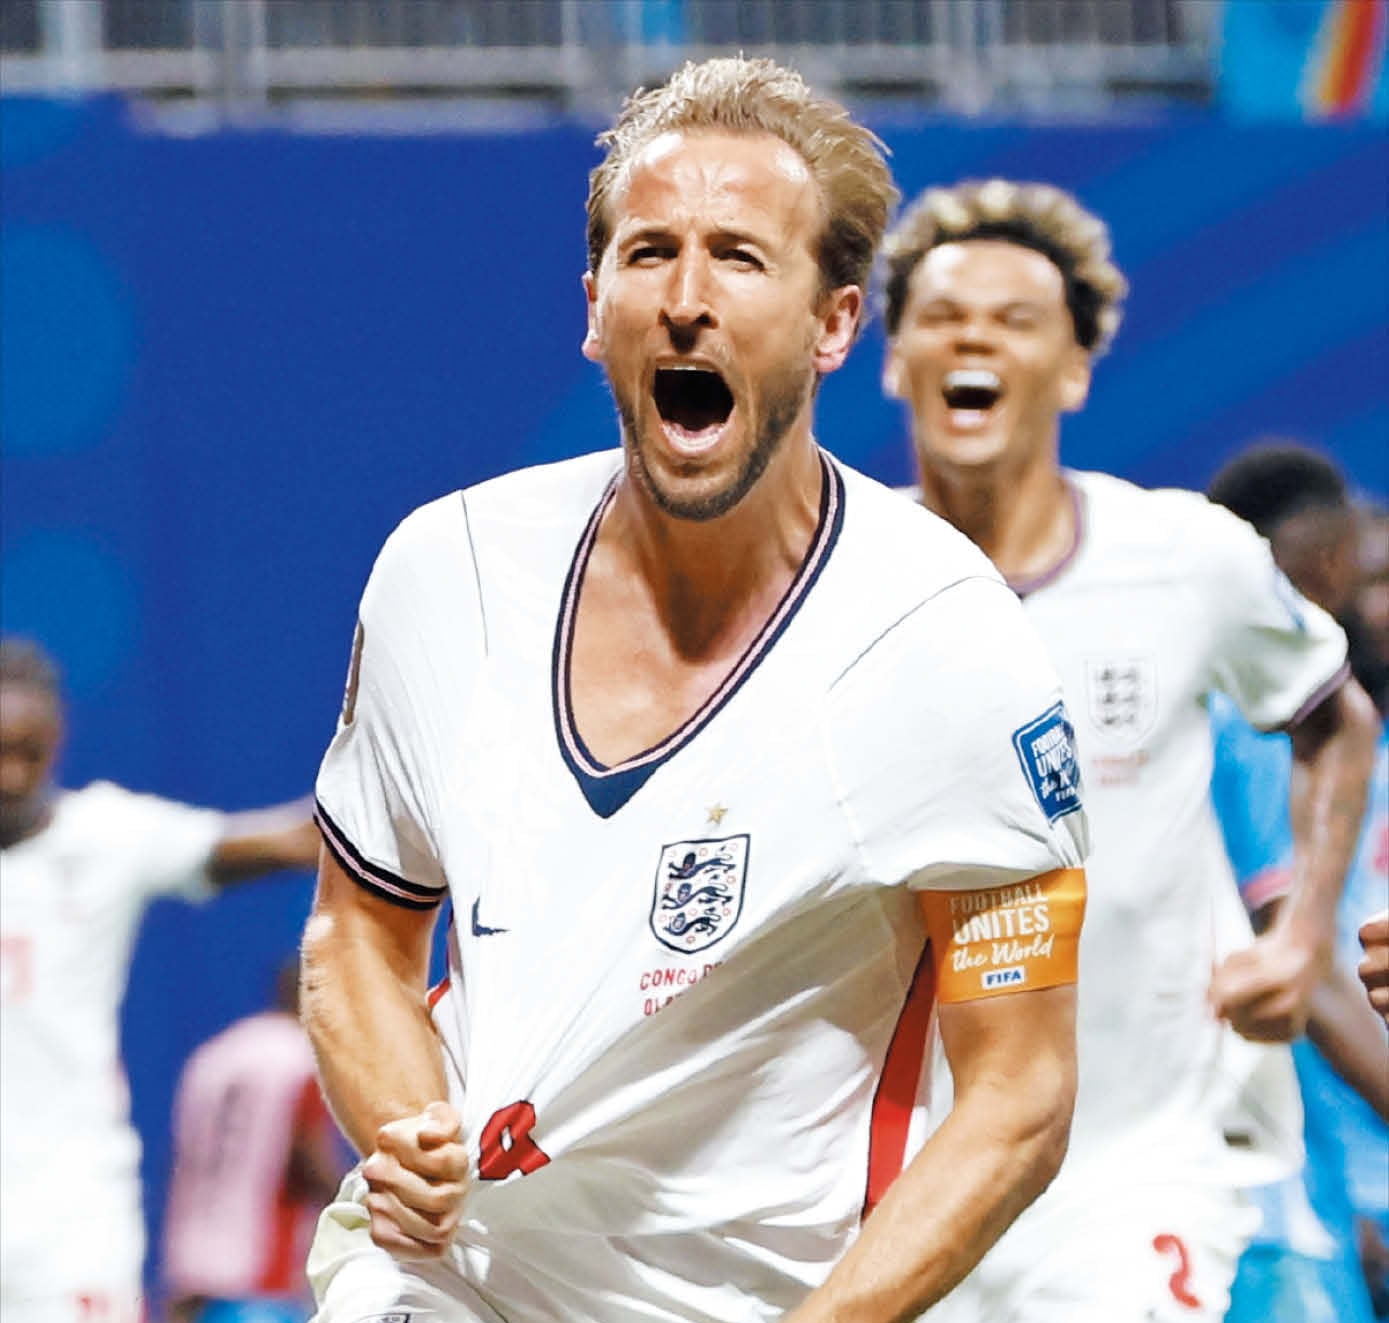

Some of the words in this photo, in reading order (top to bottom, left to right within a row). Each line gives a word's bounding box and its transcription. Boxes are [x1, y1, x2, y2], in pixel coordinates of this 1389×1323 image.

[950, 883, 1048, 914] FOOTBALL
[953, 904, 1050, 945] UNITES
[952, 946, 988, 973] the
[992, 933, 1055, 965] World
[640, 968, 697, 990] CONGO
[986, 970, 1021, 985] FIFA
[1153, 1233, 1201, 1309] 2
